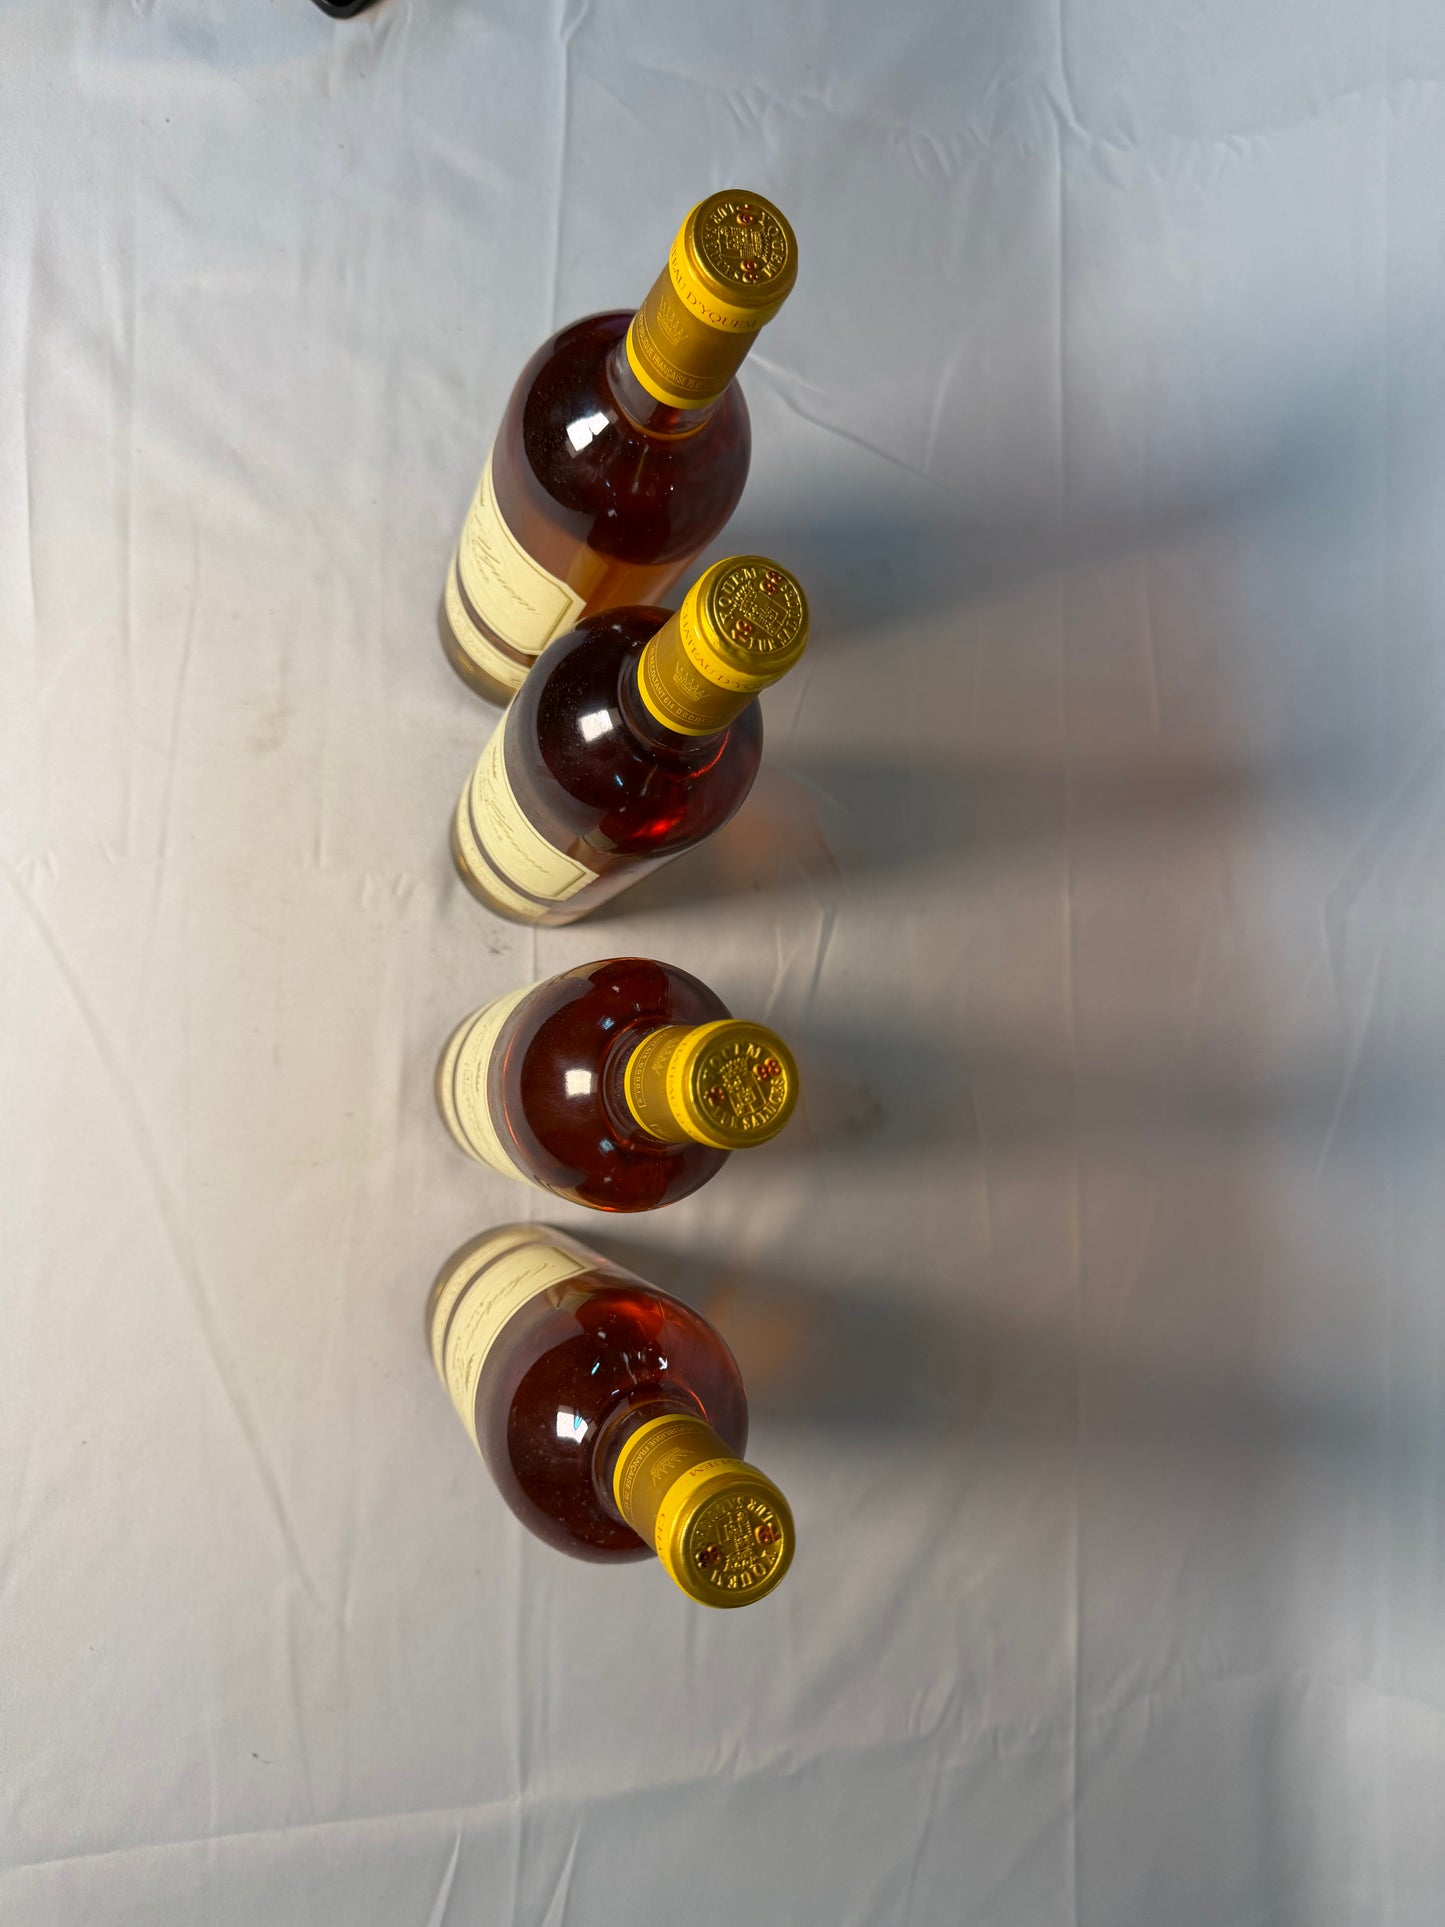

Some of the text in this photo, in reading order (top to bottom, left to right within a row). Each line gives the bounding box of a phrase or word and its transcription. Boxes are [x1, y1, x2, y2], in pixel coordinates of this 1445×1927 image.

[758, 212, 784, 278] YQUEM
[687, 295, 757, 329] D'YQUEM
[718, 568, 757, 623] YQUEM
[742, 1077, 785, 1130] SALUCES
[710, 1549, 777, 1589] YQUEM
